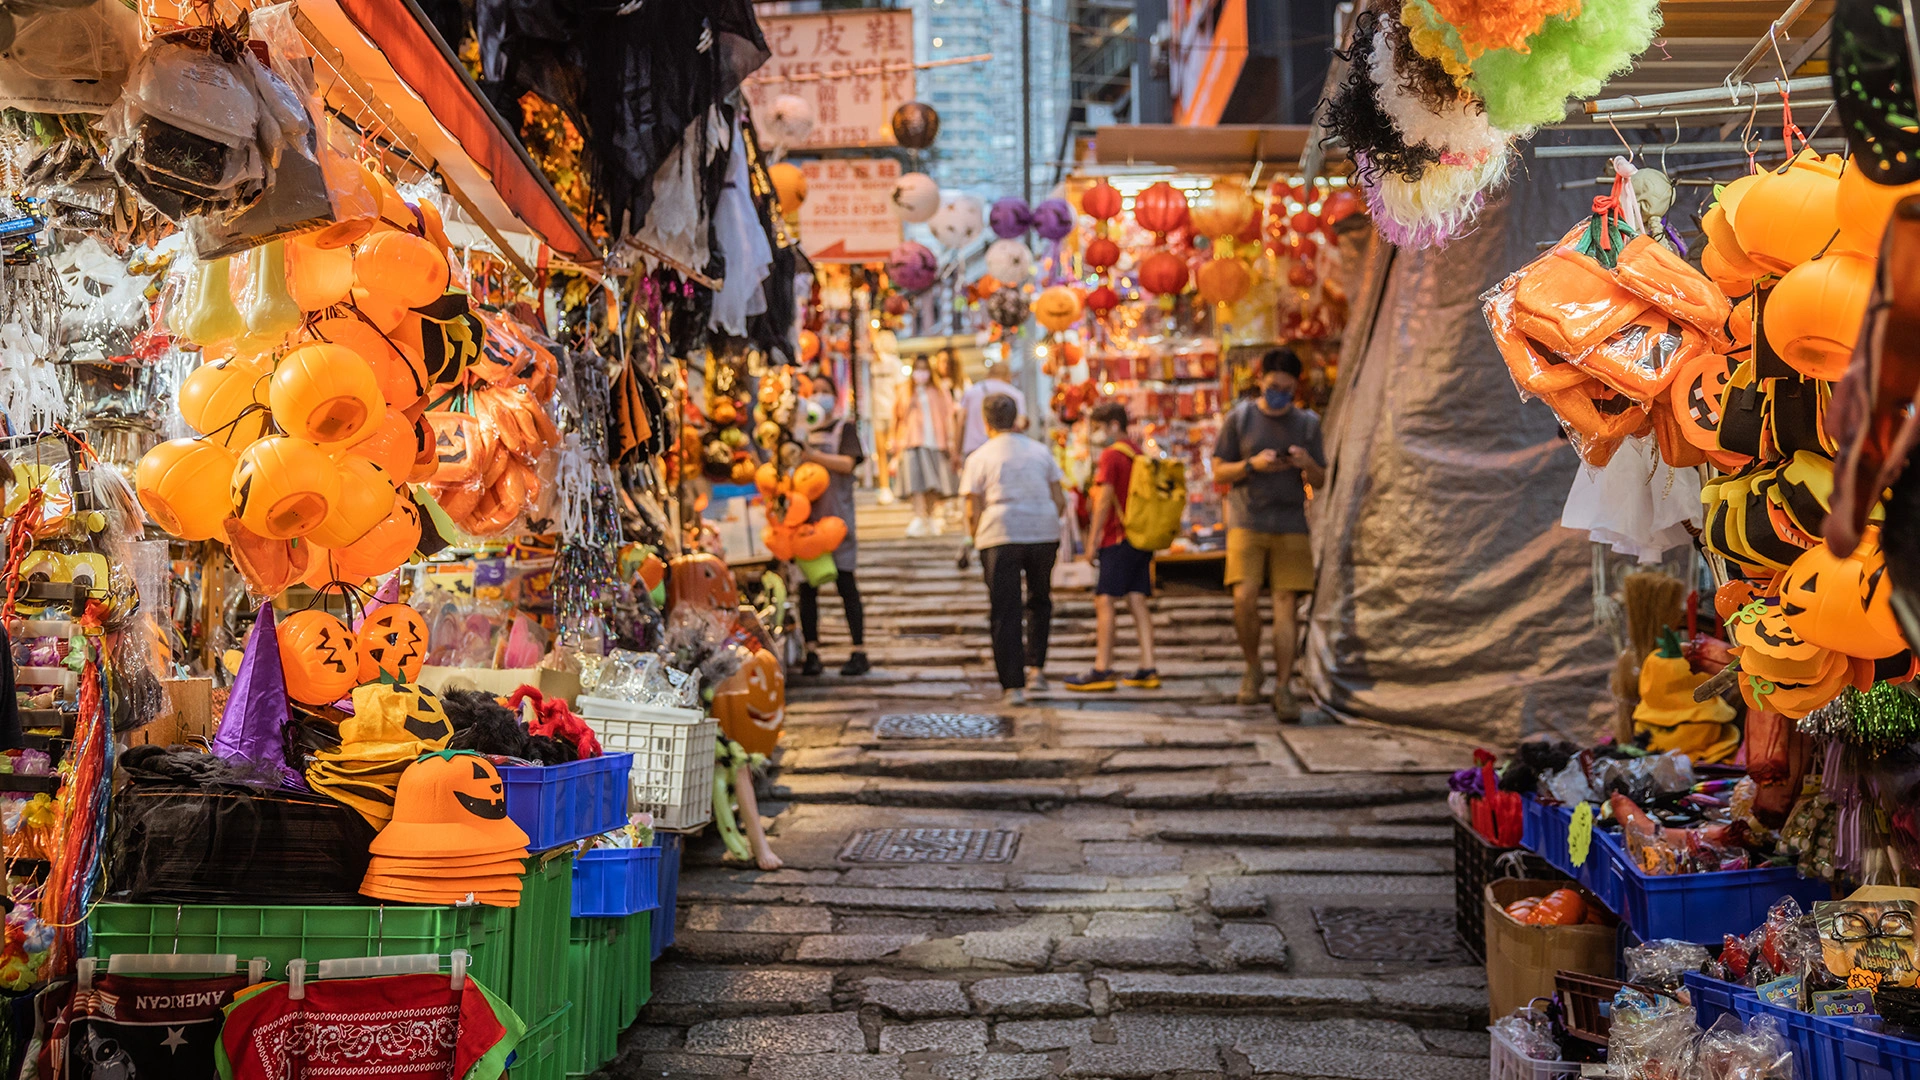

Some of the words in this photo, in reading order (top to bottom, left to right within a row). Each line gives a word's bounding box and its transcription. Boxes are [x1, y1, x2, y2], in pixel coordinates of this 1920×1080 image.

[1867, 942, 1900, 960] PARTY
[1861, 954, 1911, 970] HALLOWEEN
[136, 990, 225, 1009] AMERICAN
